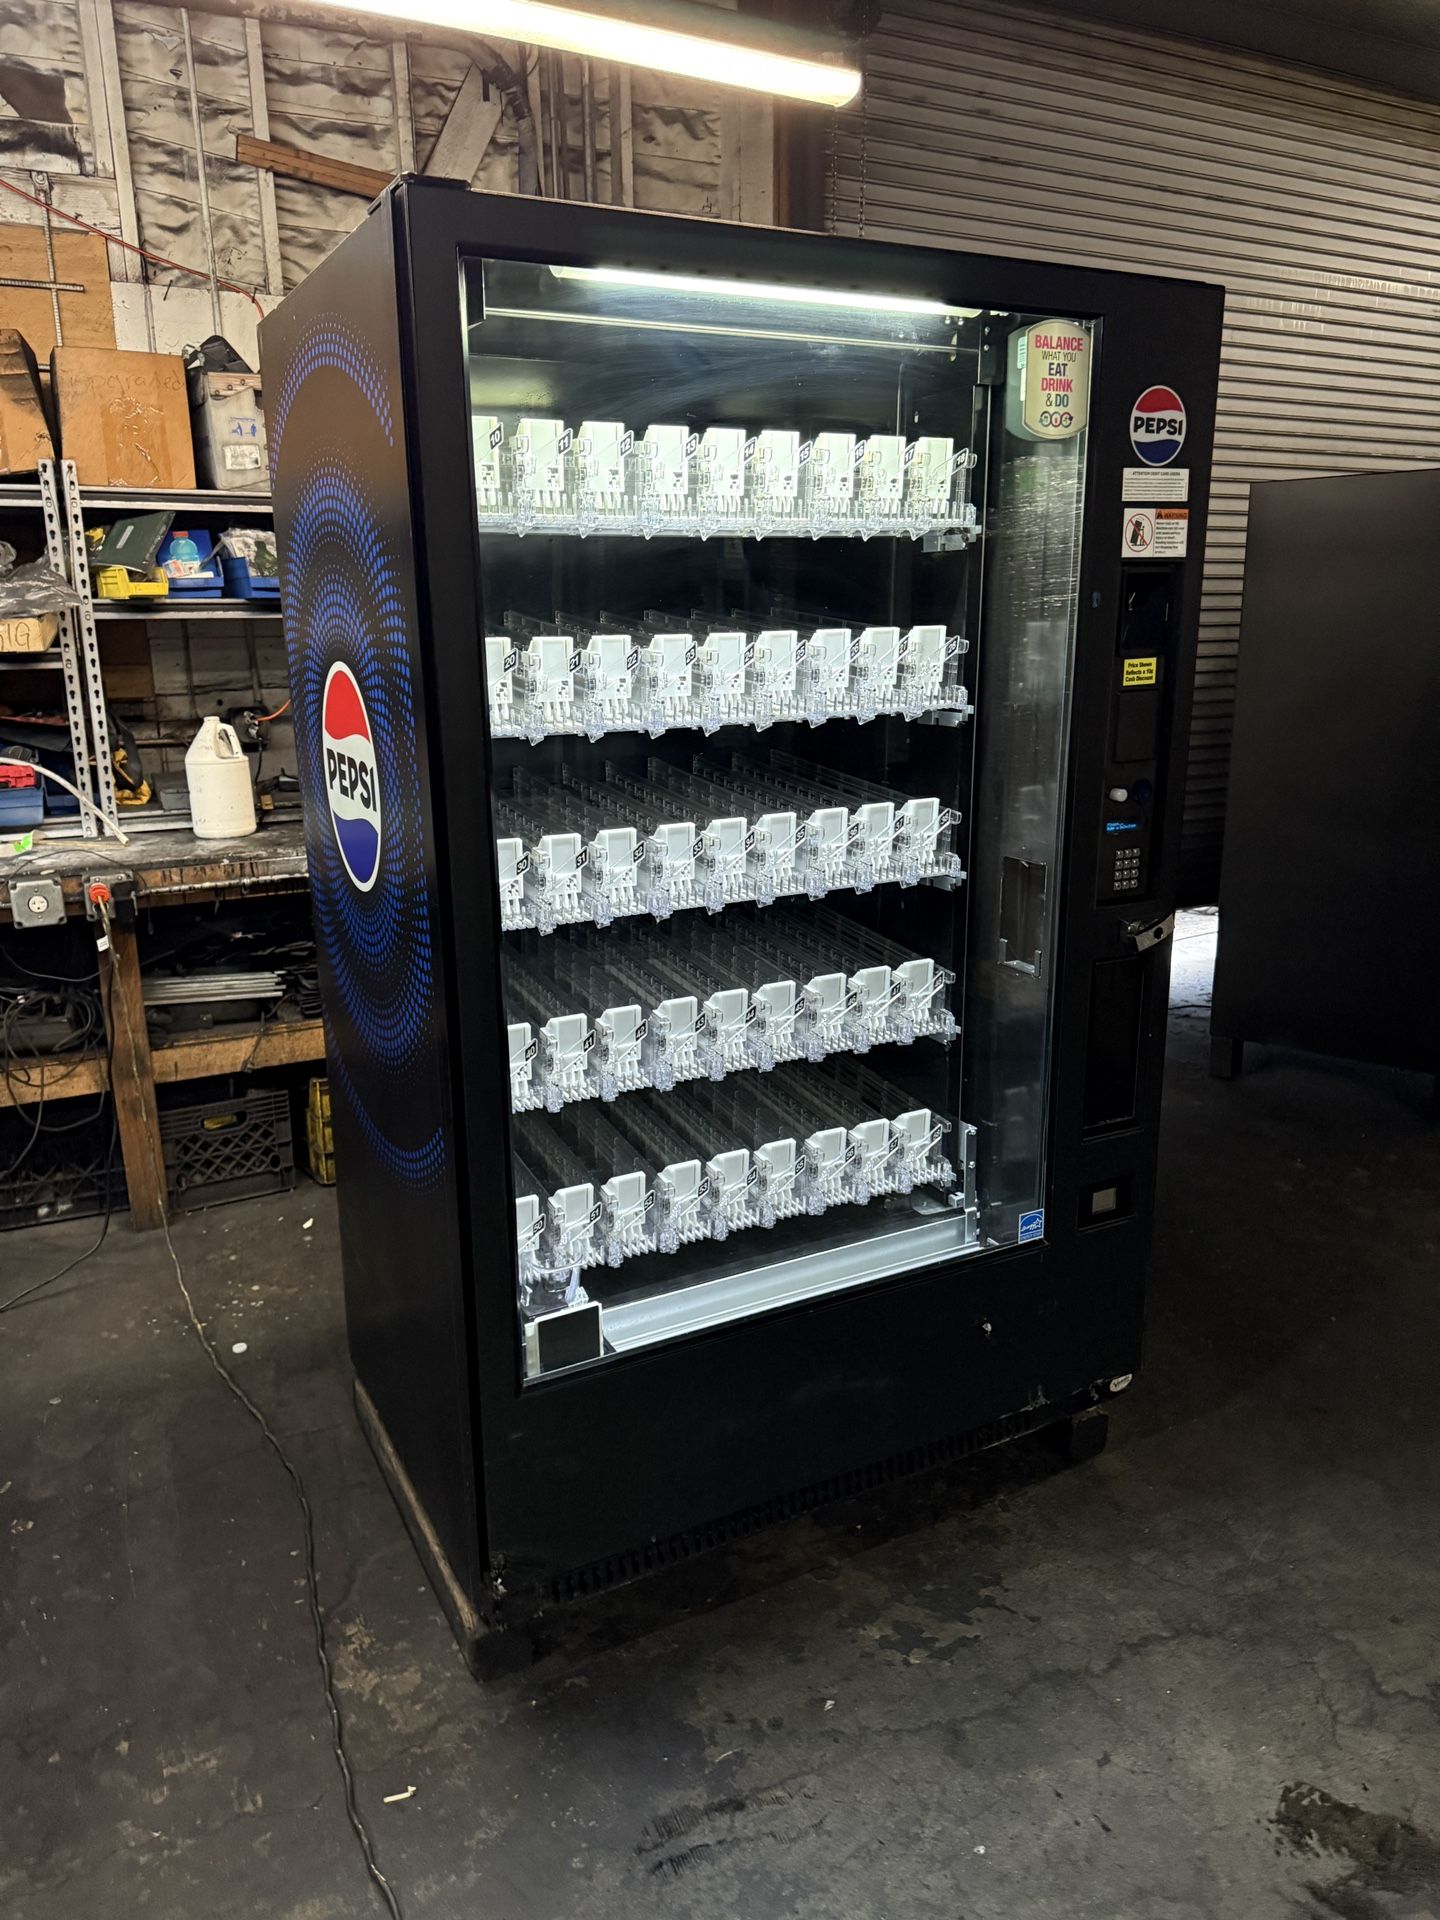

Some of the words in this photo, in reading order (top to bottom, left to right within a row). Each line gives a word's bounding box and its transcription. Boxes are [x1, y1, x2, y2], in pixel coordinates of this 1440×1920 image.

[1034, 335, 1084, 351] BALANCE
[1042, 350, 1061, 360] WHAT
[1063, 351, 1077, 362] YOU
[1048, 363, 1068, 376] EAT
[1041, 378, 1073, 392] DRINK
[1045, 393, 1053, 407] &
[1055, 394, 1069, 407] DO
[1133, 416, 1183, 436] PEPSI
[491, 431, 500, 446] 10
[560, 436, 569, 451] 11
[621, 438, 631, 453] 12
[687, 440, 696, 455] 13
[745, 447, 754, 458] 14
[855, 447, 864, 458] 16
[800, 450, 809, 461] 15
[905, 450, 913, 461] 17
[326, 747, 377, 812] PEPSI
